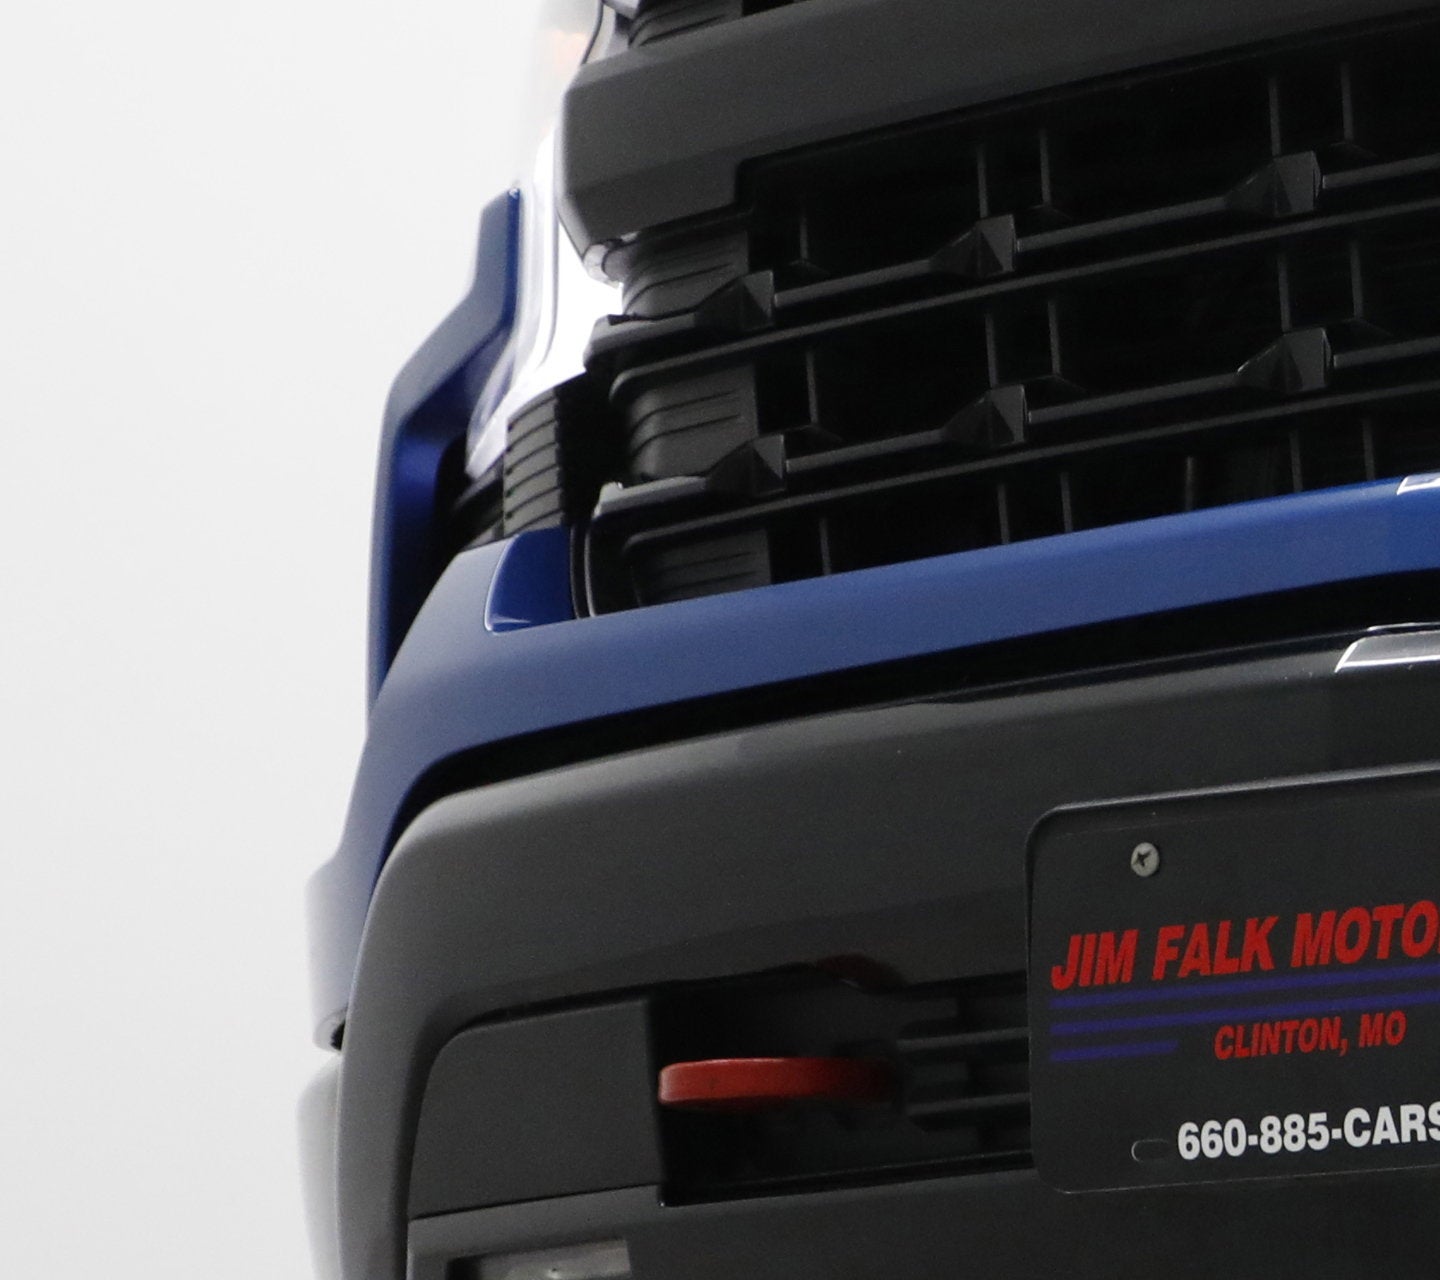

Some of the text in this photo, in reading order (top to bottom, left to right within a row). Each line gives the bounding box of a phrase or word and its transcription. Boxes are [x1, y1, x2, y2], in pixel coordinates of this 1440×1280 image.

[1051, 928, 1137, 990] JIM
[1152, 916, 1278, 979] FALK
[1213, 1010, 1406, 1060] CLINTON, MO
